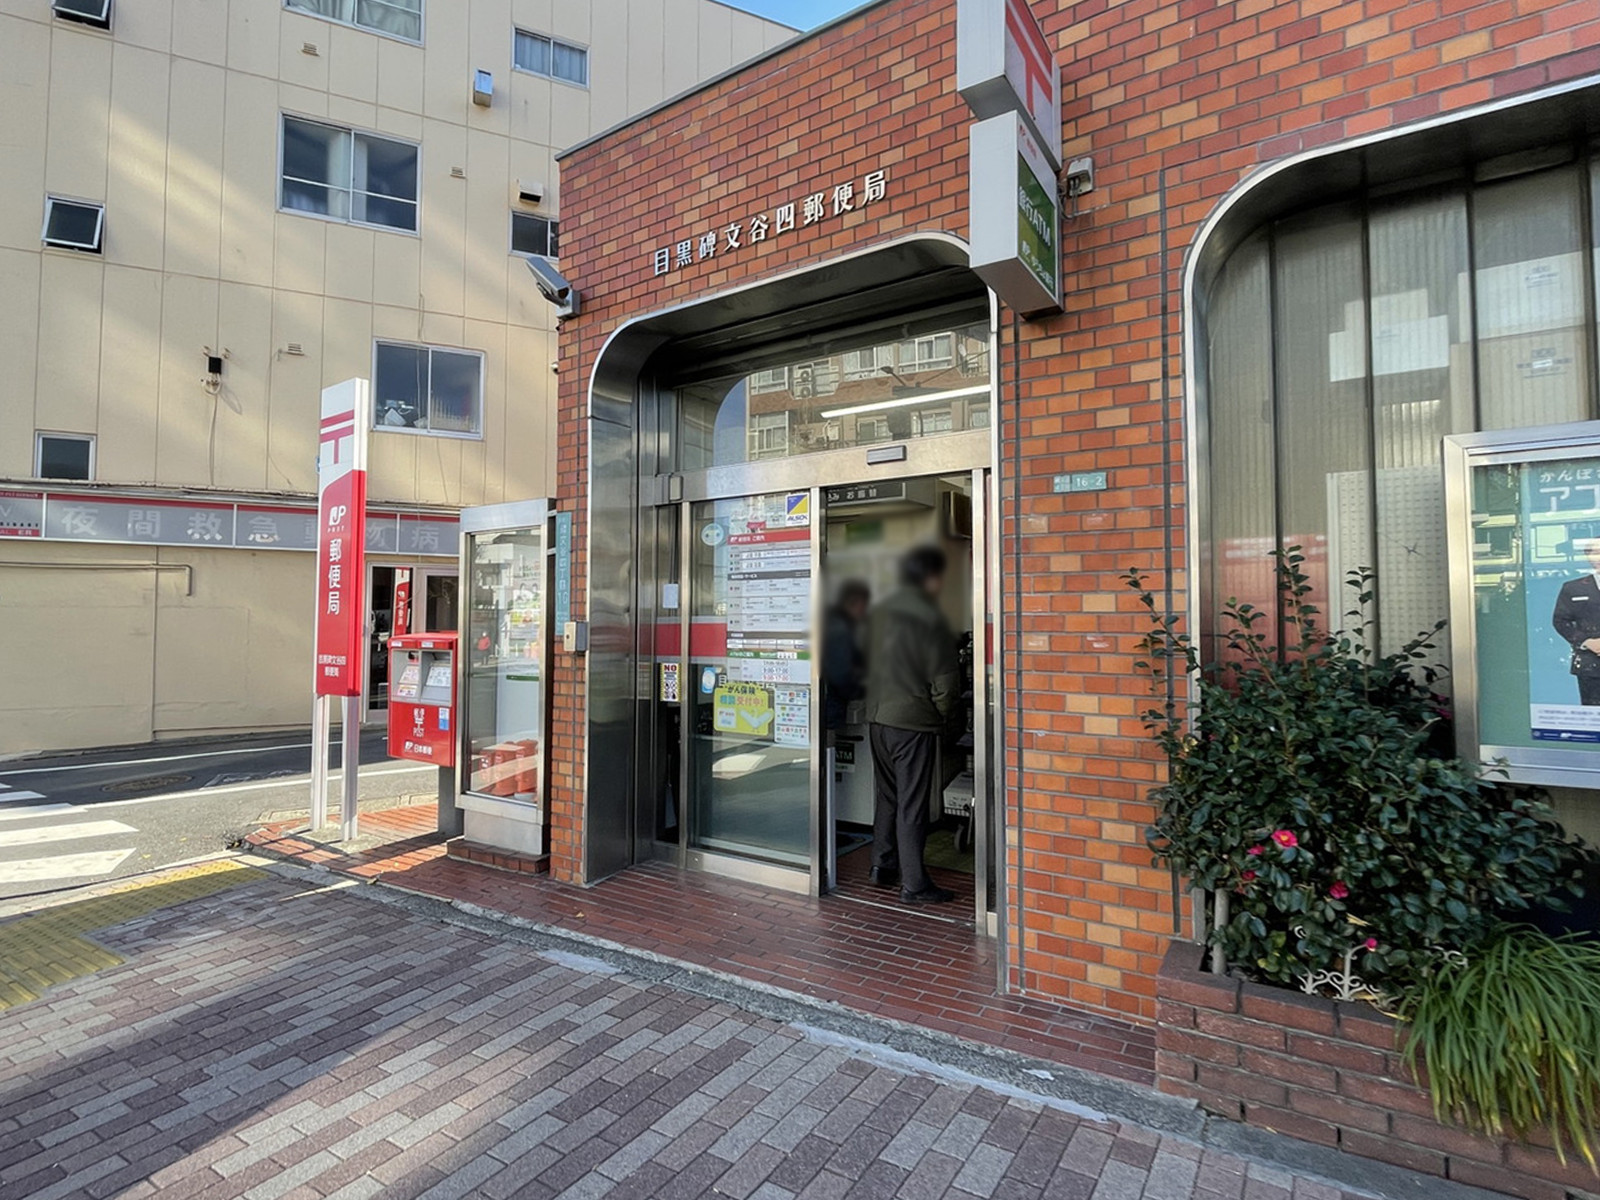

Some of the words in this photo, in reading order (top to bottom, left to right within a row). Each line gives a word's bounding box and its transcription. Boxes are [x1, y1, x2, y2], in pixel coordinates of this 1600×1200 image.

[654, 169, 887, 276] 目黒碑文谷四郵便局
[327, 538, 343, 615] 郵便局
[663, 664, 678, 672] NO
